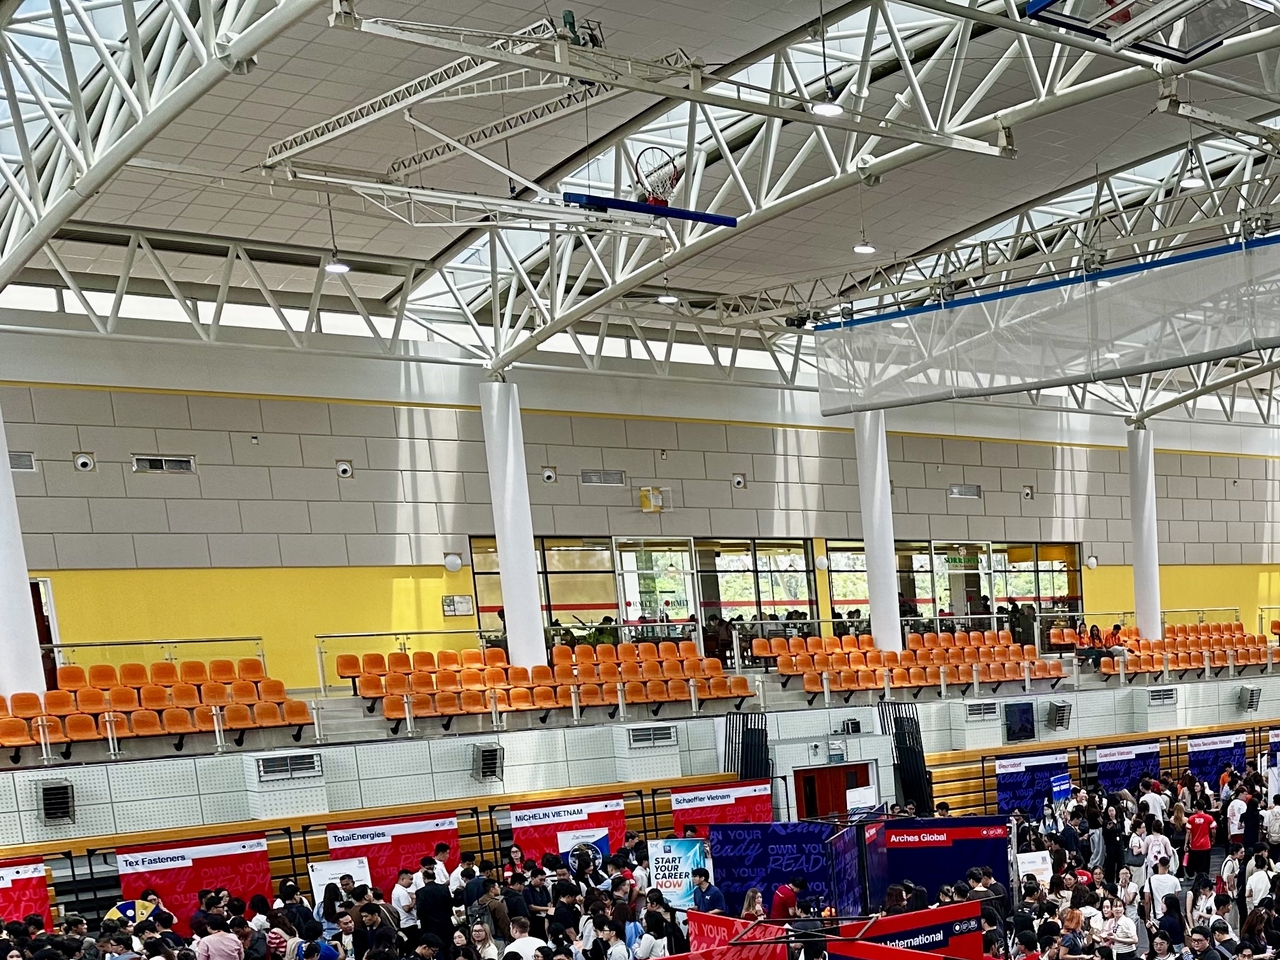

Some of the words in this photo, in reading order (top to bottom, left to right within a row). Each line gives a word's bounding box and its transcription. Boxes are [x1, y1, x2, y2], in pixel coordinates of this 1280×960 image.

[675, 796, 705, 805] Schaeffler
[706, 793, 730, 802] Vietnam
[515, 812, 550, 822] MICHELIN
[551, 808, 583, 818] VIETNAM
[333, 831, 386, 843] TotalEnergies
[728, 830, 762, 840] YOUR
[890, 834, 919, 842] Arches
[920, 833, 947, 841] Global
[768, 845, 797, 855] OWN
[123, 859, 140, 867] Tex
[141, 855, 186, 866] Fasteners
[654, 857, 682, 865] START
[654, 864, 679, 872] YOUR
[654, 872, 690, 880] CAREER
[655, 880, 683, 889] NOW
[701, 924, 728, 941] YOUR
